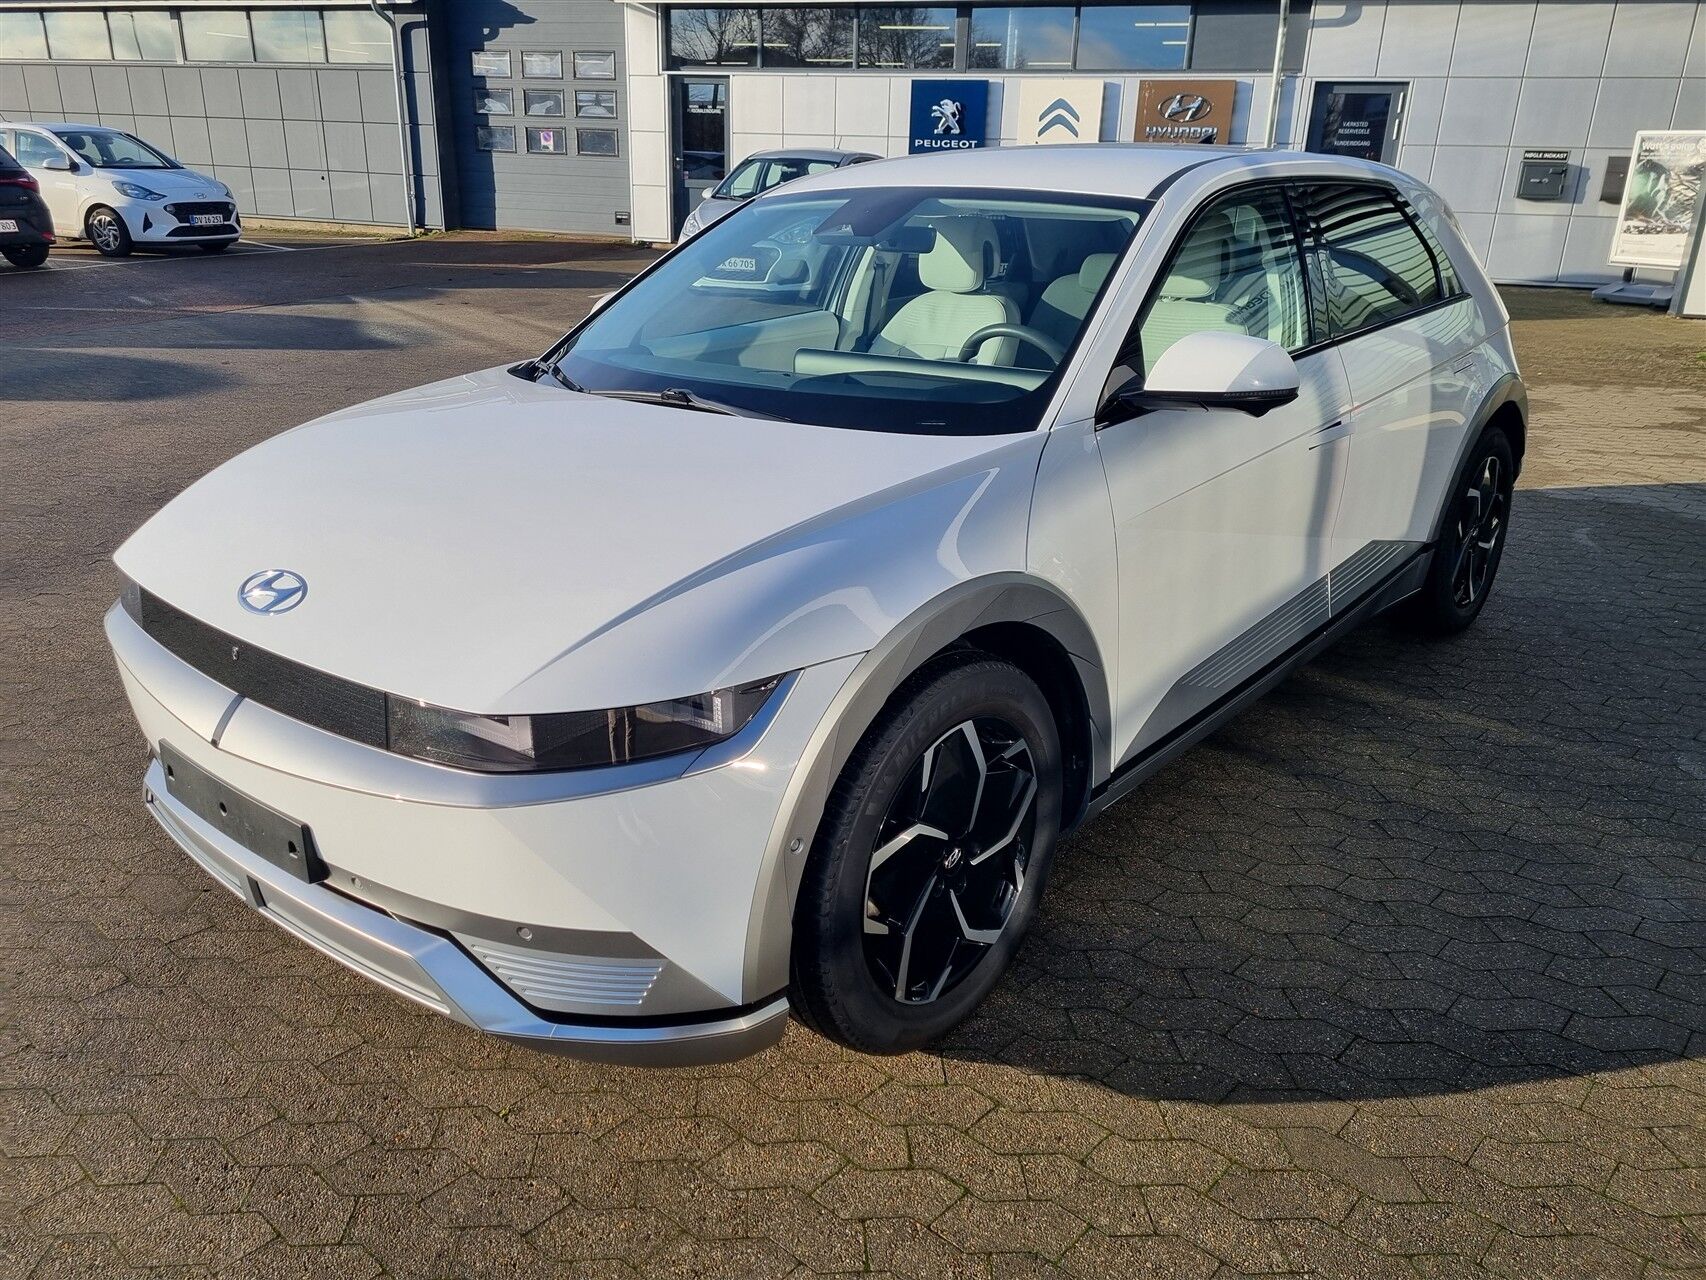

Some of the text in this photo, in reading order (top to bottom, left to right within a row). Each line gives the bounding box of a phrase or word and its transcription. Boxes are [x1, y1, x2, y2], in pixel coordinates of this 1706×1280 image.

[1145, 126, 1218, 138] HYUNDAI
[914, 139, 978, 149] PEUGEOT
[204, 216, 211, 224] 16
[0, 221, 17, 230] 803
[728, 259, 738, 268] 66
[740, 259, 754, 269] 705
